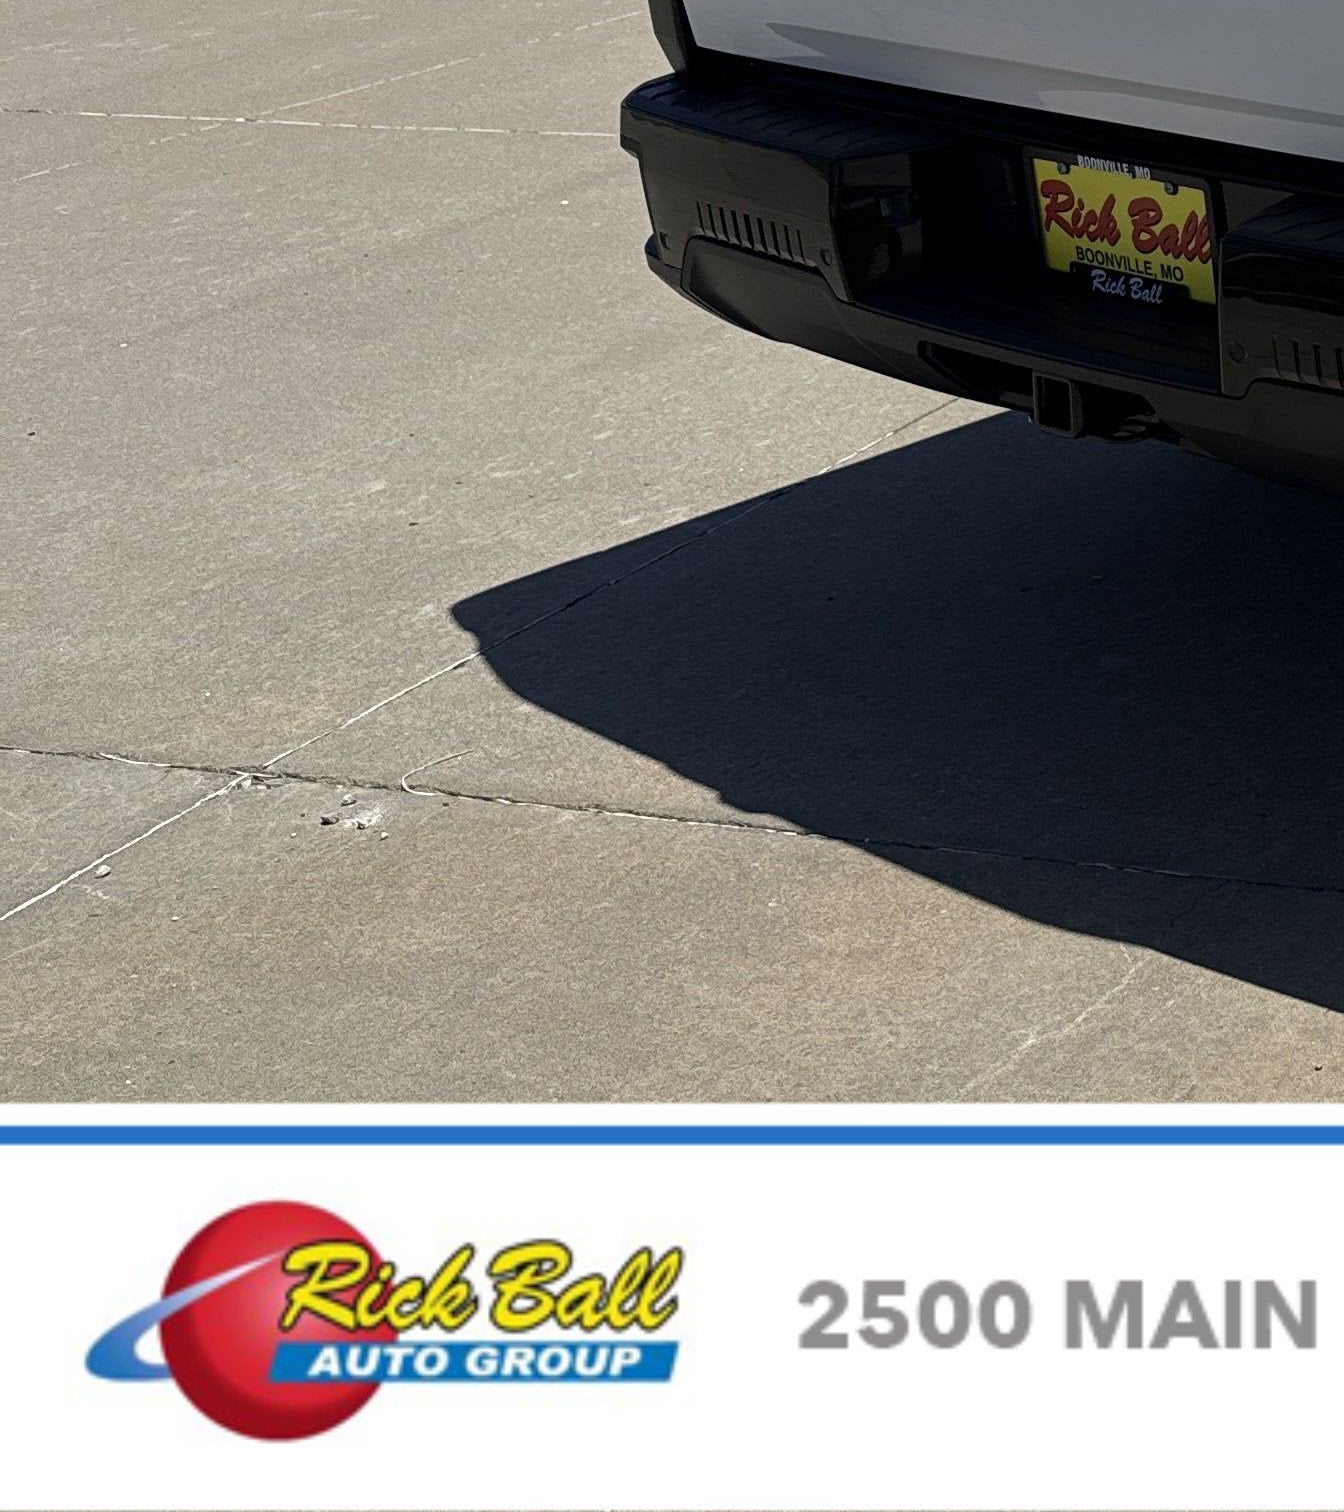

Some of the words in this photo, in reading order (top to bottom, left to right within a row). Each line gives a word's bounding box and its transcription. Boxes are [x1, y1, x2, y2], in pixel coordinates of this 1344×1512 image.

[1076, 154, 1134, 178] BOONVILLE,
[1134, 164, 1151, 179] MO
[1039, 178, 1122, 247] Rick
[1127, 196, 1212, 265] Ball
[1075, 245, 1158, 281] BOONVILLE,
[1160, 263, 1185, 282] MO
[1090, 268, 1127, 298] Rick
[1128, 277, 1164, 305] Ball
